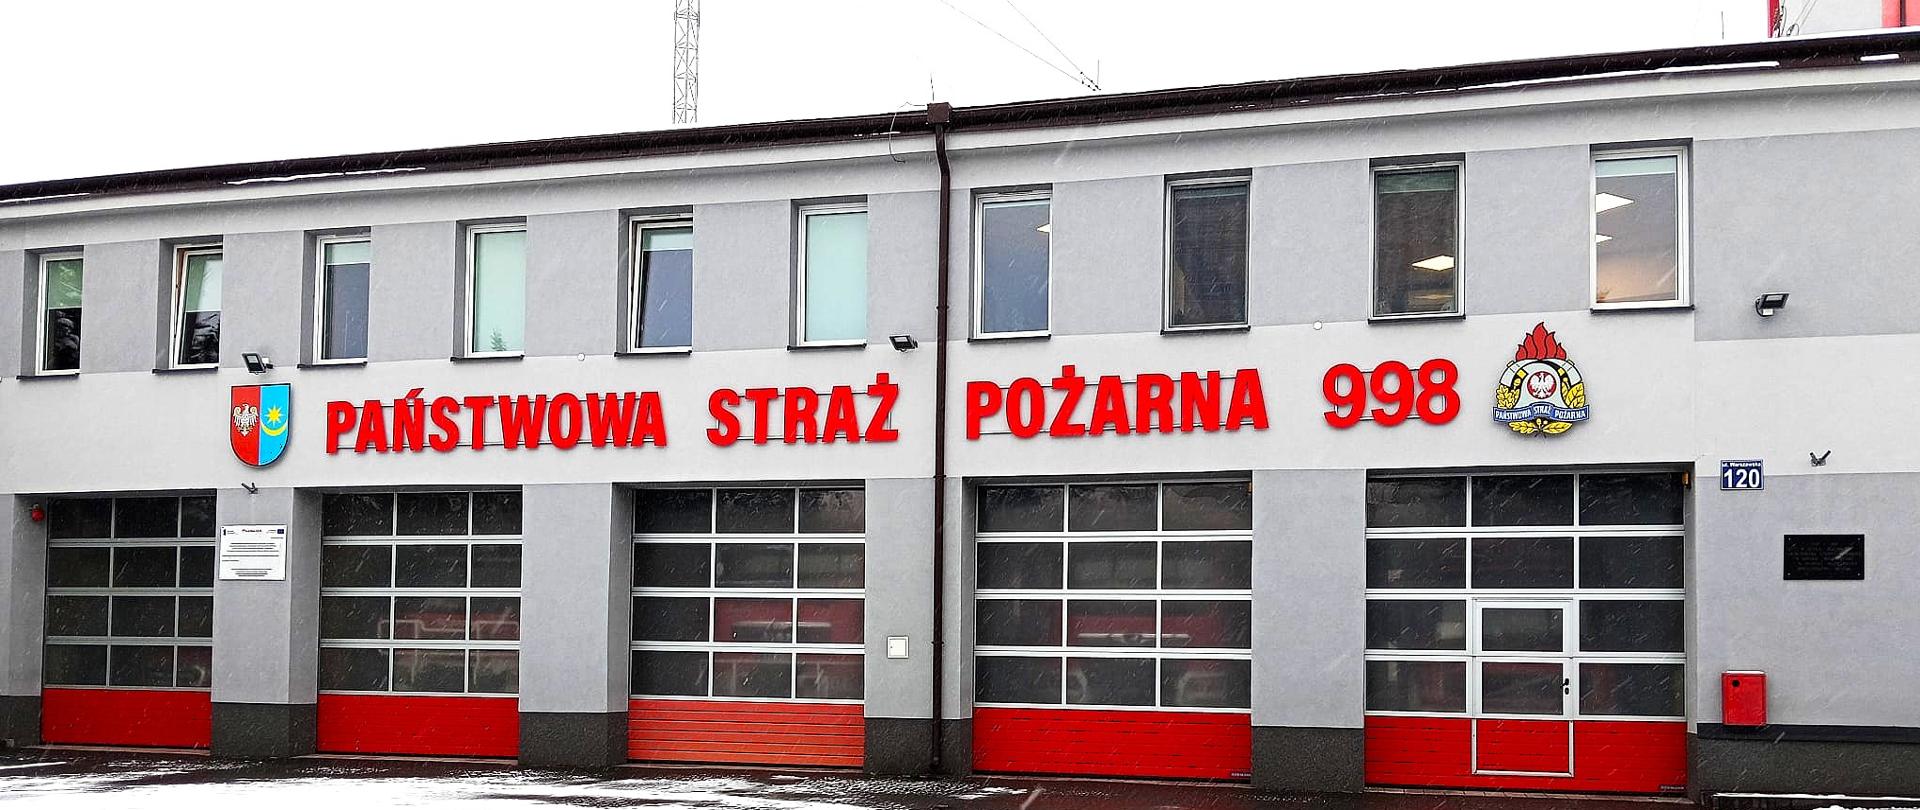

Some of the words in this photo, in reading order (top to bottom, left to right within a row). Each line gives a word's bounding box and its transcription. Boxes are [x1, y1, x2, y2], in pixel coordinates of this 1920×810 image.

[326, 388, 667, 455] PAŃSTWOWA
[706, 373, 899, 447] STRAŻ
[966, 364, 1269, 440] POŻARNA
[1323, 358, 1461, 429] 998
[1533, 405, 1551, 414] STRAŻ
[1554, 410, 1586, 420] POŻARNA
[1723, 468, 1760, 488] 120
